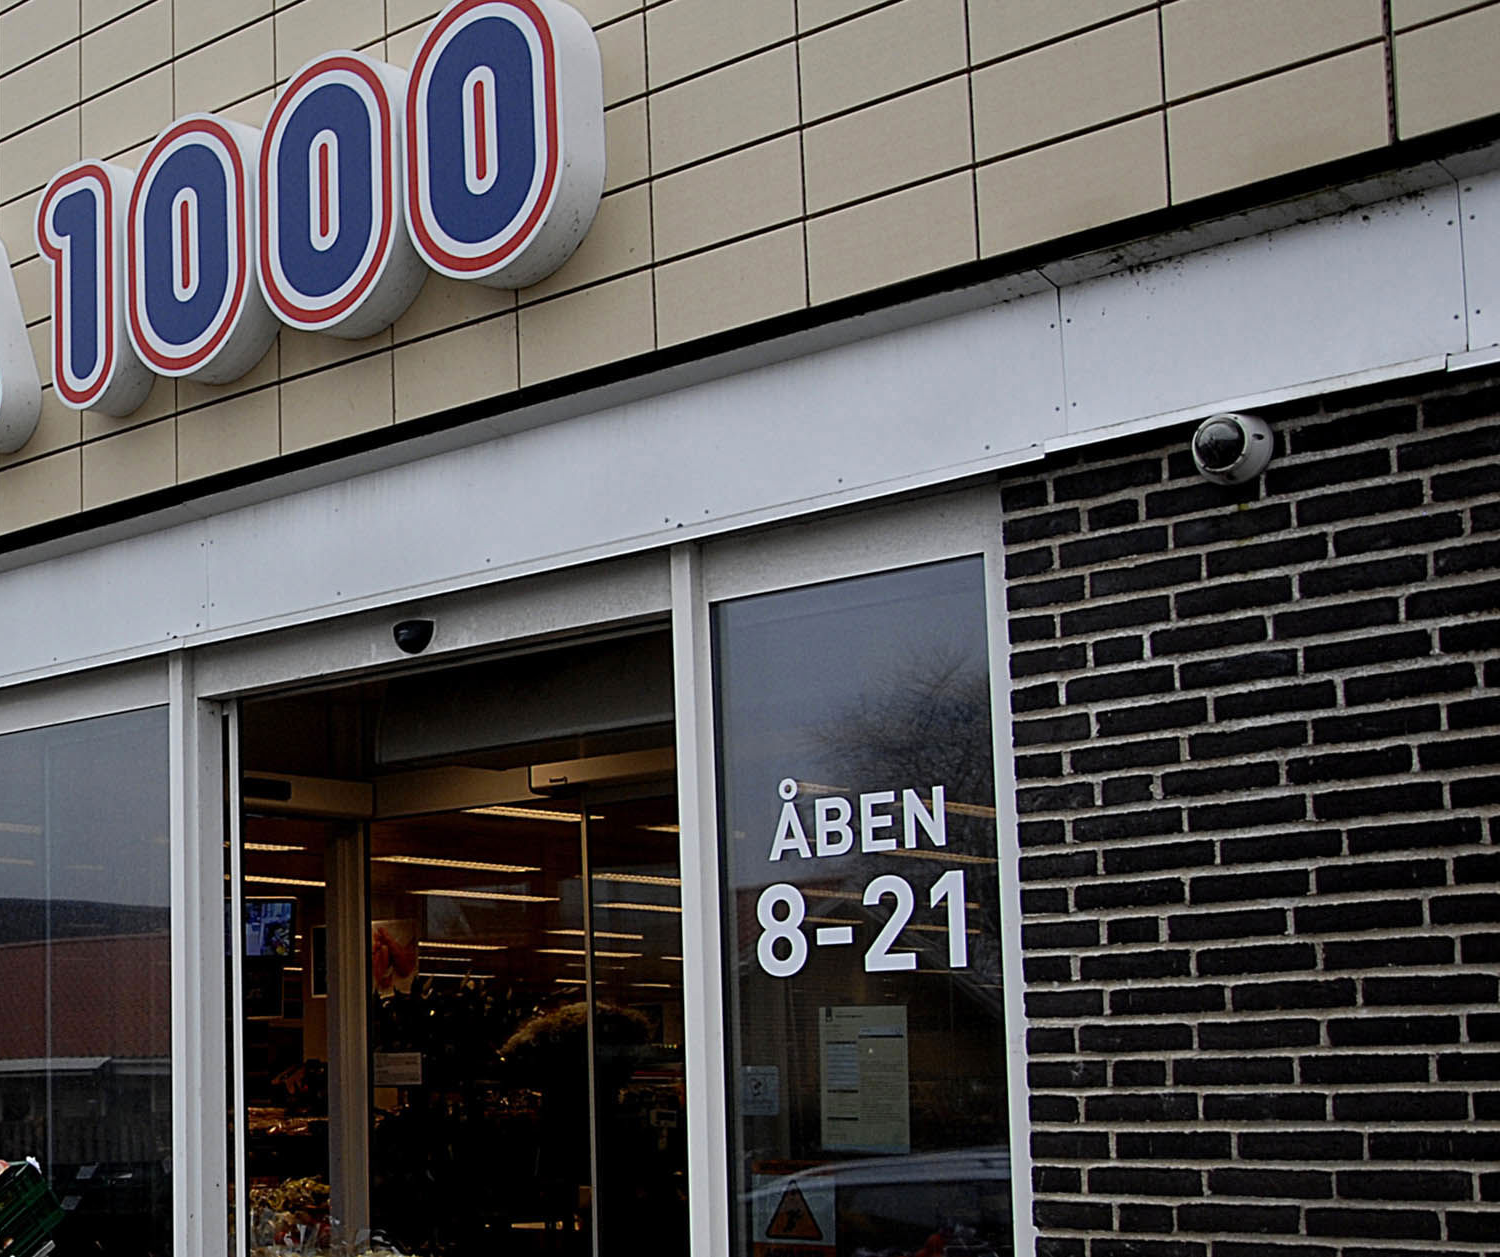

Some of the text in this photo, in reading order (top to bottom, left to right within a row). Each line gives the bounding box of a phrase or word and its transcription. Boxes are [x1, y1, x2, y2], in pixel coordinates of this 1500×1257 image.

[35, 0, 562, 411] 1000
[769, 778, 947, 861] ÅBEN
[757, 870, 967, 977] 8-21
